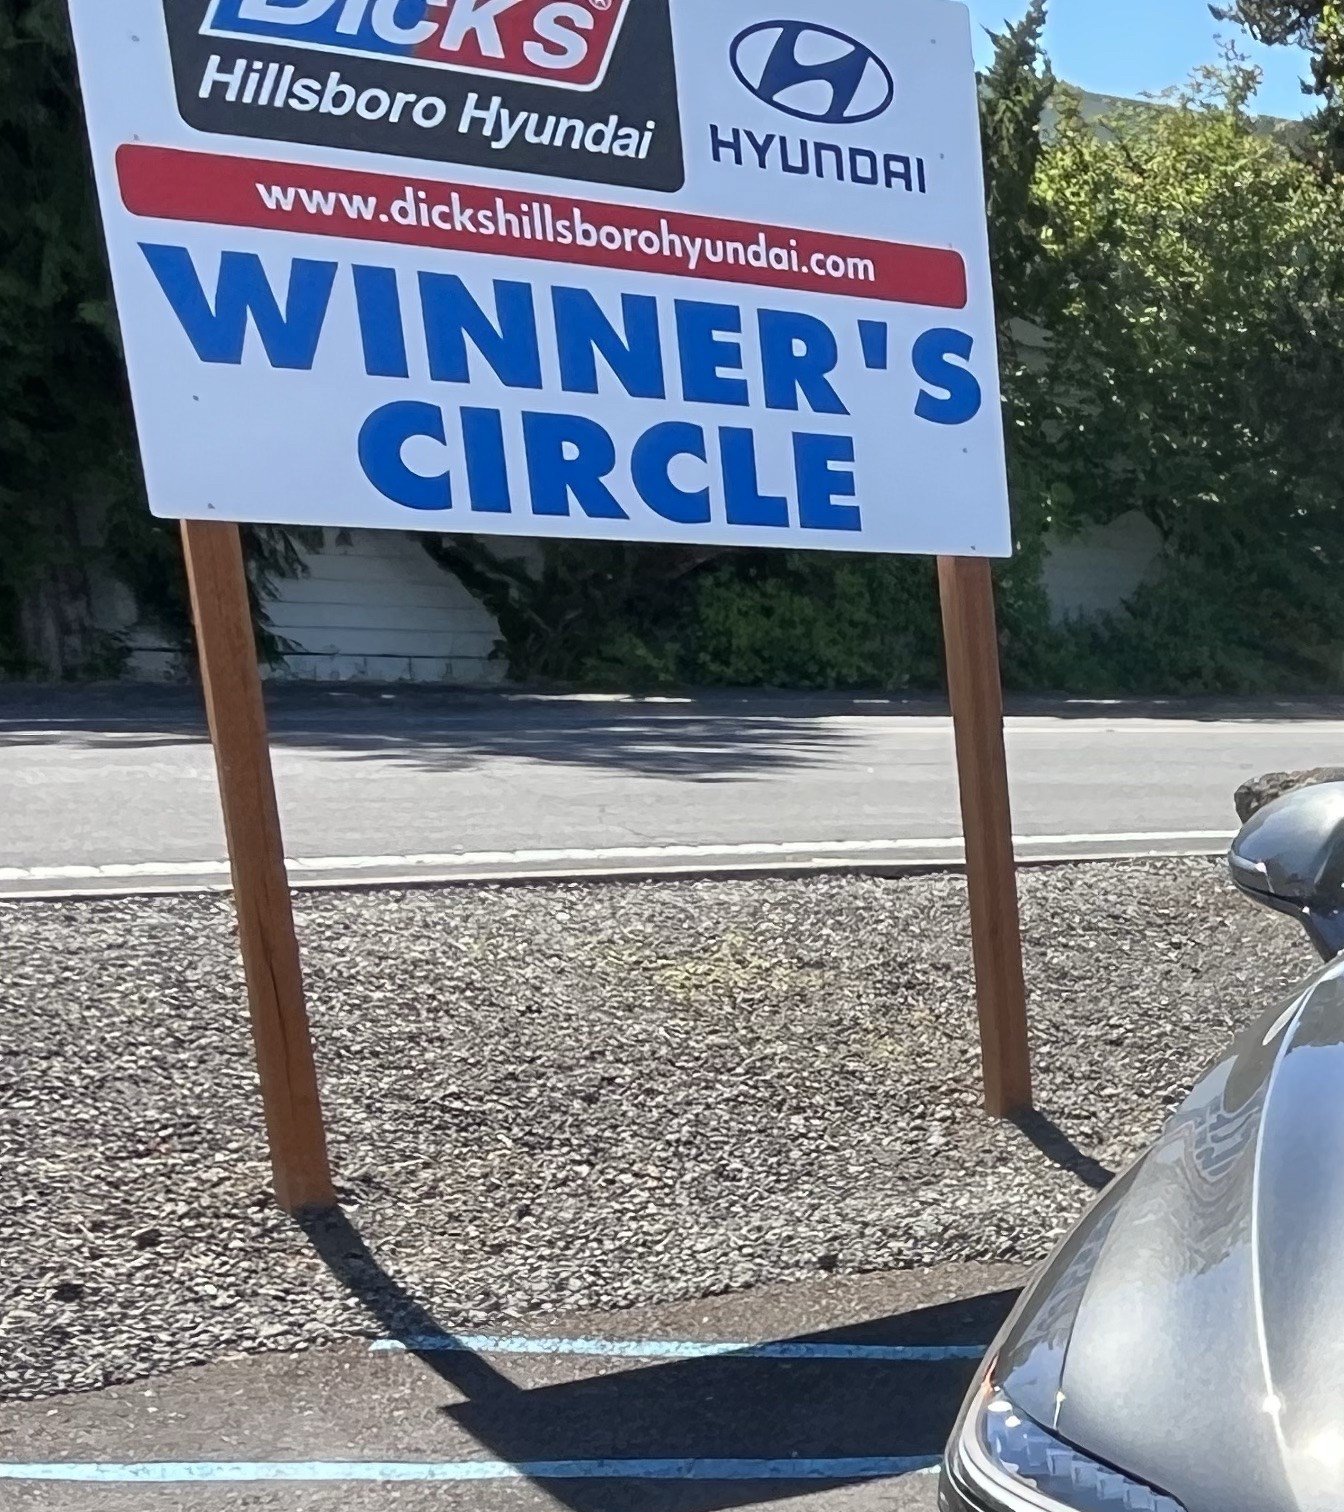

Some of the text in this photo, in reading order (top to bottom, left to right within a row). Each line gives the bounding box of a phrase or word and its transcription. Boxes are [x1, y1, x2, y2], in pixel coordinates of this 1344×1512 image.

[198, 54, 655, 160] Hillsboro Hyundai
[709, 123, 926, 195] HYUNDAI
[256, 178, 876, 282] www.dickshillsborohyundai.com
[137, 241, 982, 426] WINNER'S
[357, 399, 862, 532] CIRCLE
